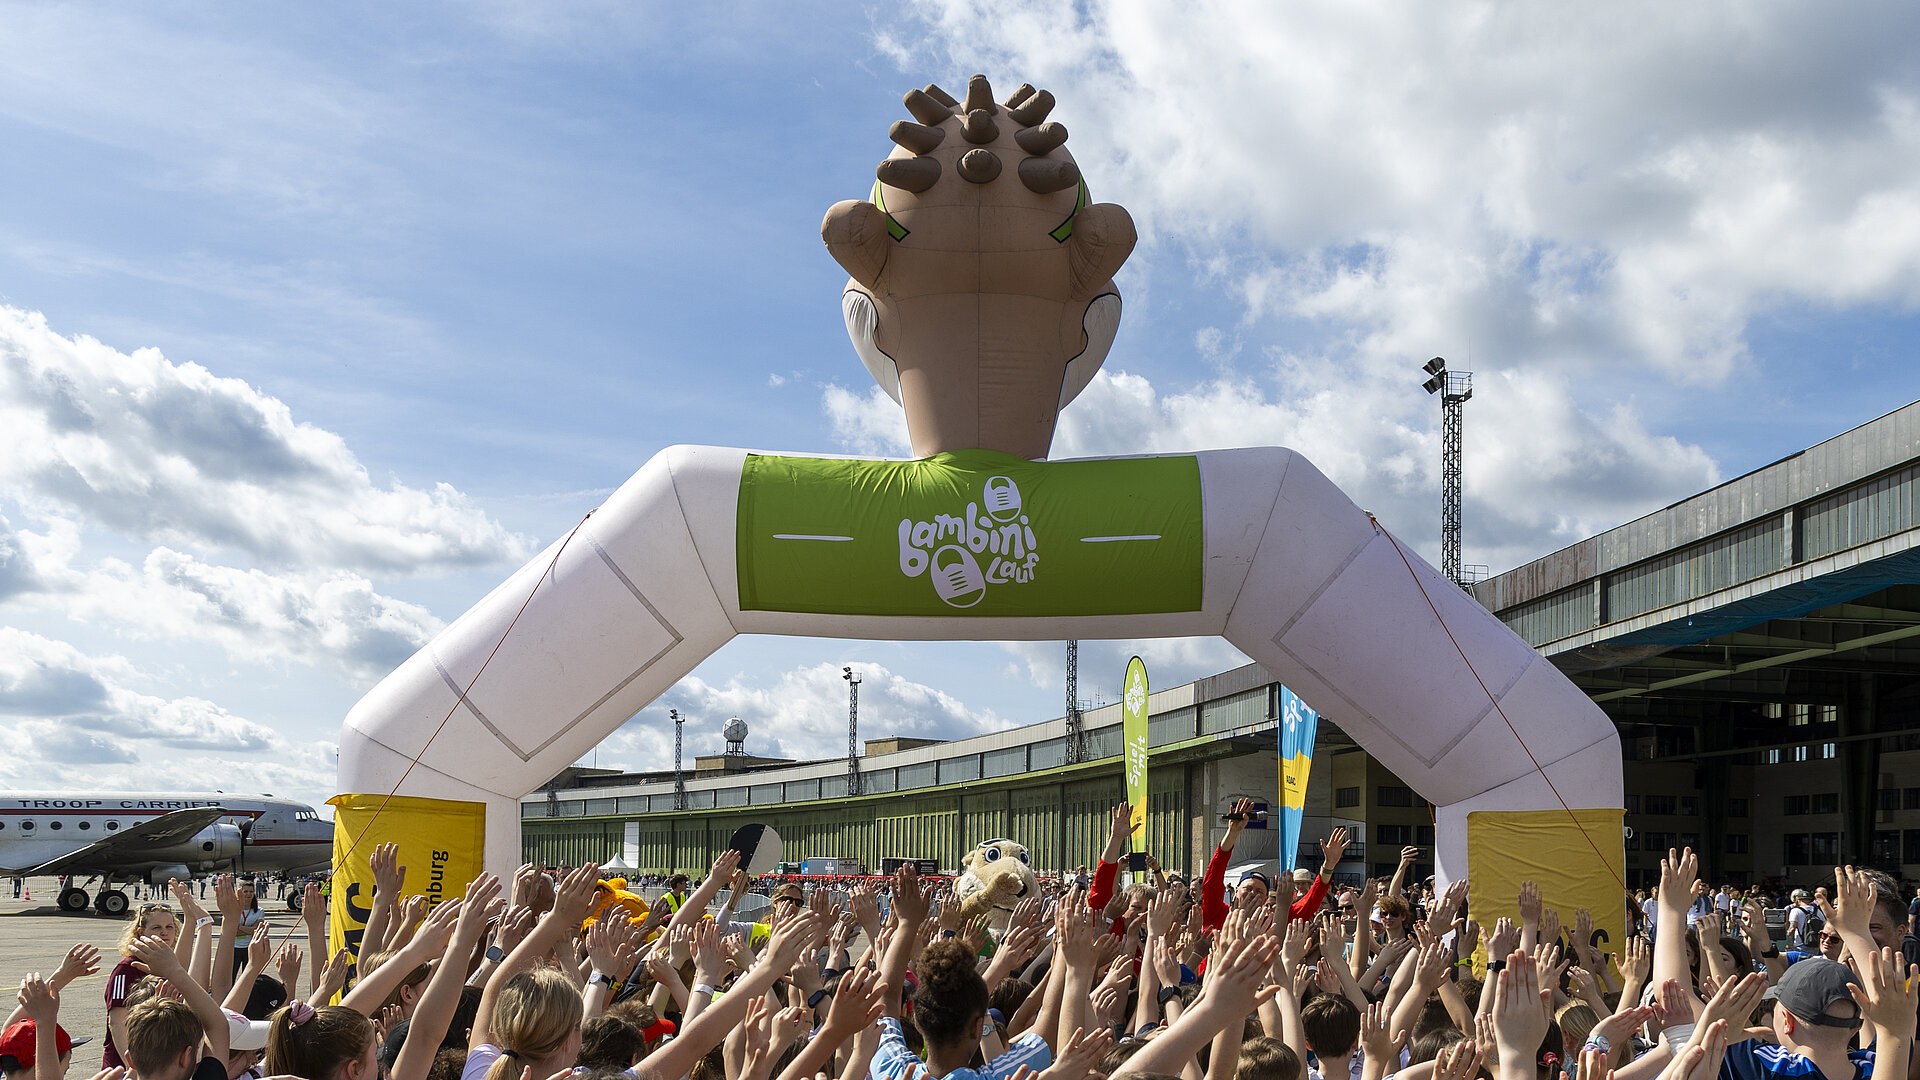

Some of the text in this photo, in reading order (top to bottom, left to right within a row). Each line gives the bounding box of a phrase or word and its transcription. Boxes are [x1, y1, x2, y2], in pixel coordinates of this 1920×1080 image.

[985, 552, 1039, 584] Lauf
[1129, 741, 1142, 788] Spiel
[1137, 735, 1146, 769] mit
[18, 800, 220, 809] TROOP CARRIER
